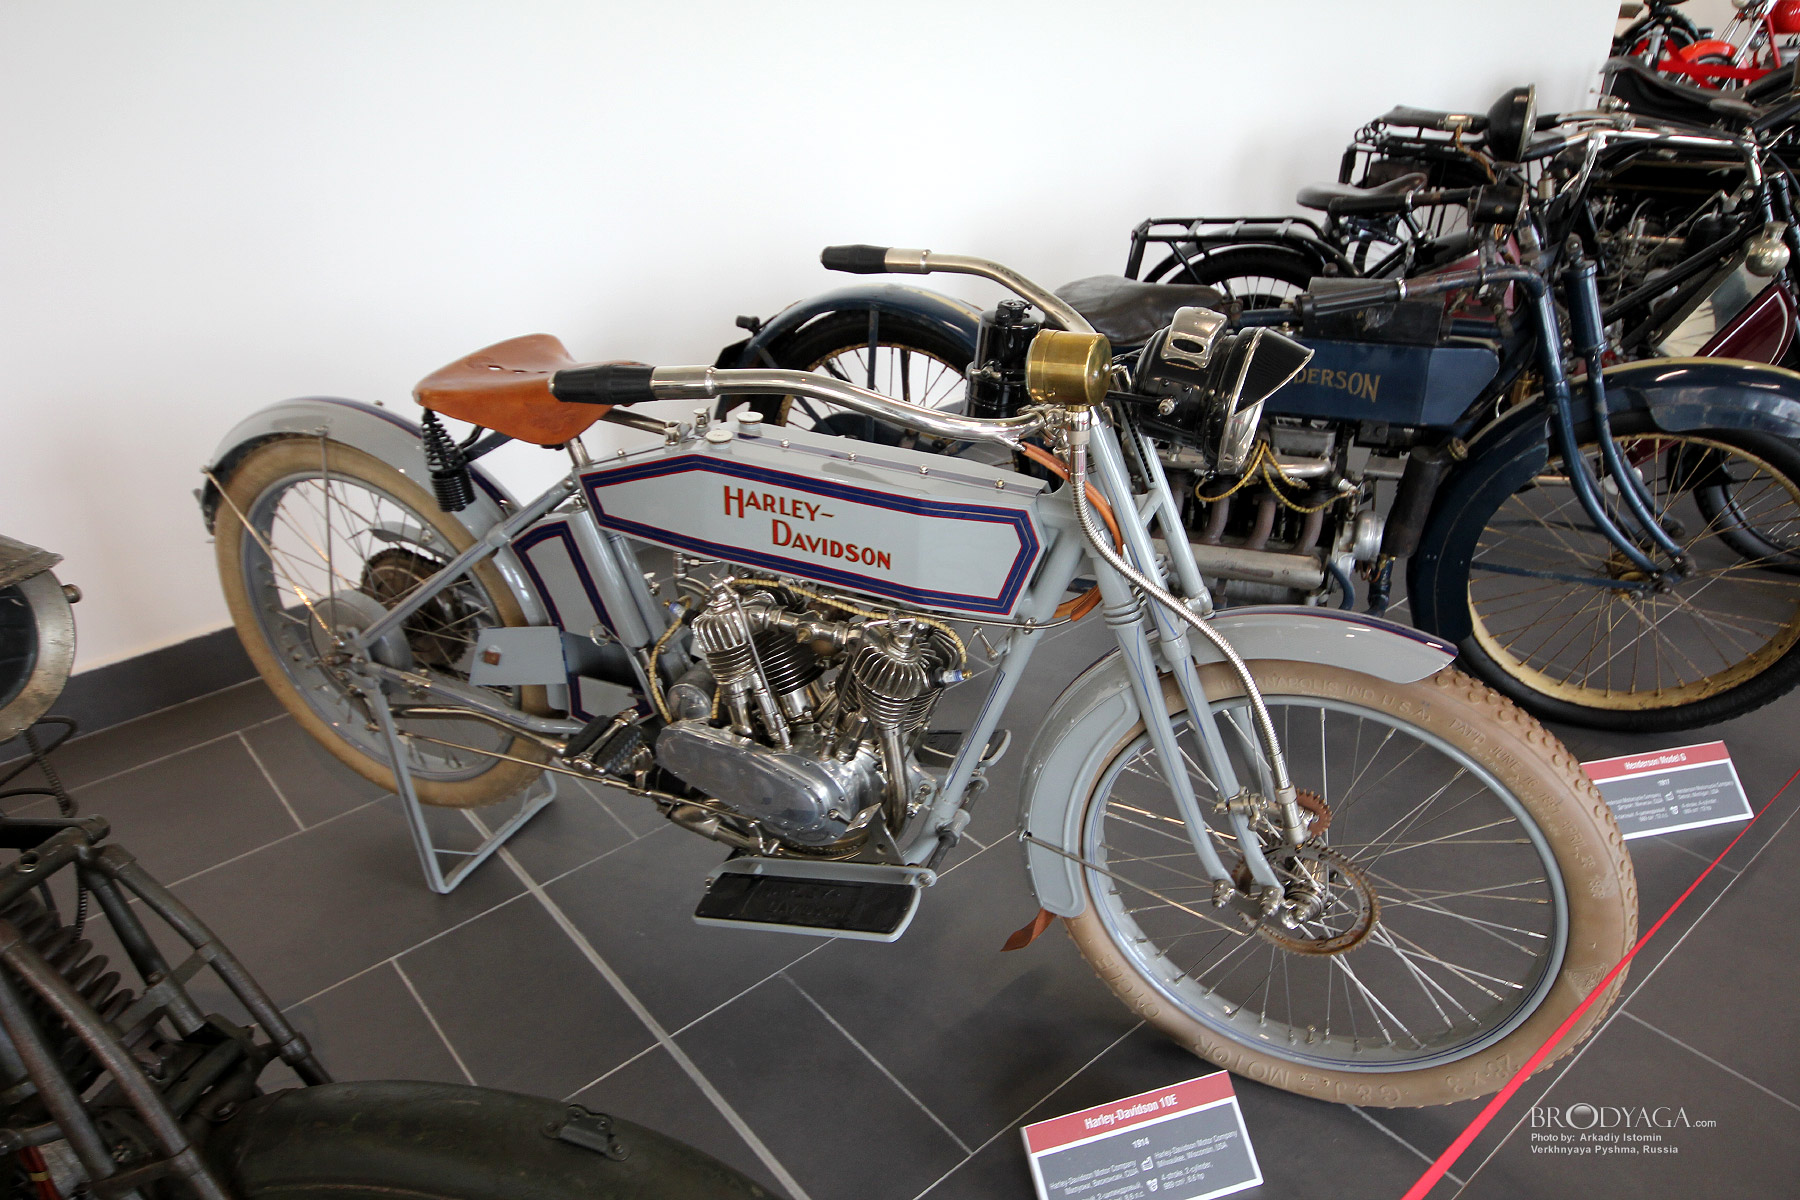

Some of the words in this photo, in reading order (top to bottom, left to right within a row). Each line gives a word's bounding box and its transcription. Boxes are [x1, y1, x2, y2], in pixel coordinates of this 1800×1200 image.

[1293, 367, 1382, 403] DERSON
[772, 518, 891, 570] DAVIDSON
[1194, 1035, 1290, 1089] MOTOR
[1084, 1103, 1159, 1130] Harley-Davidson
[1159, 1093, 1178, 1108] 10E
[1132, 1136, 1150, 1149] 1914
